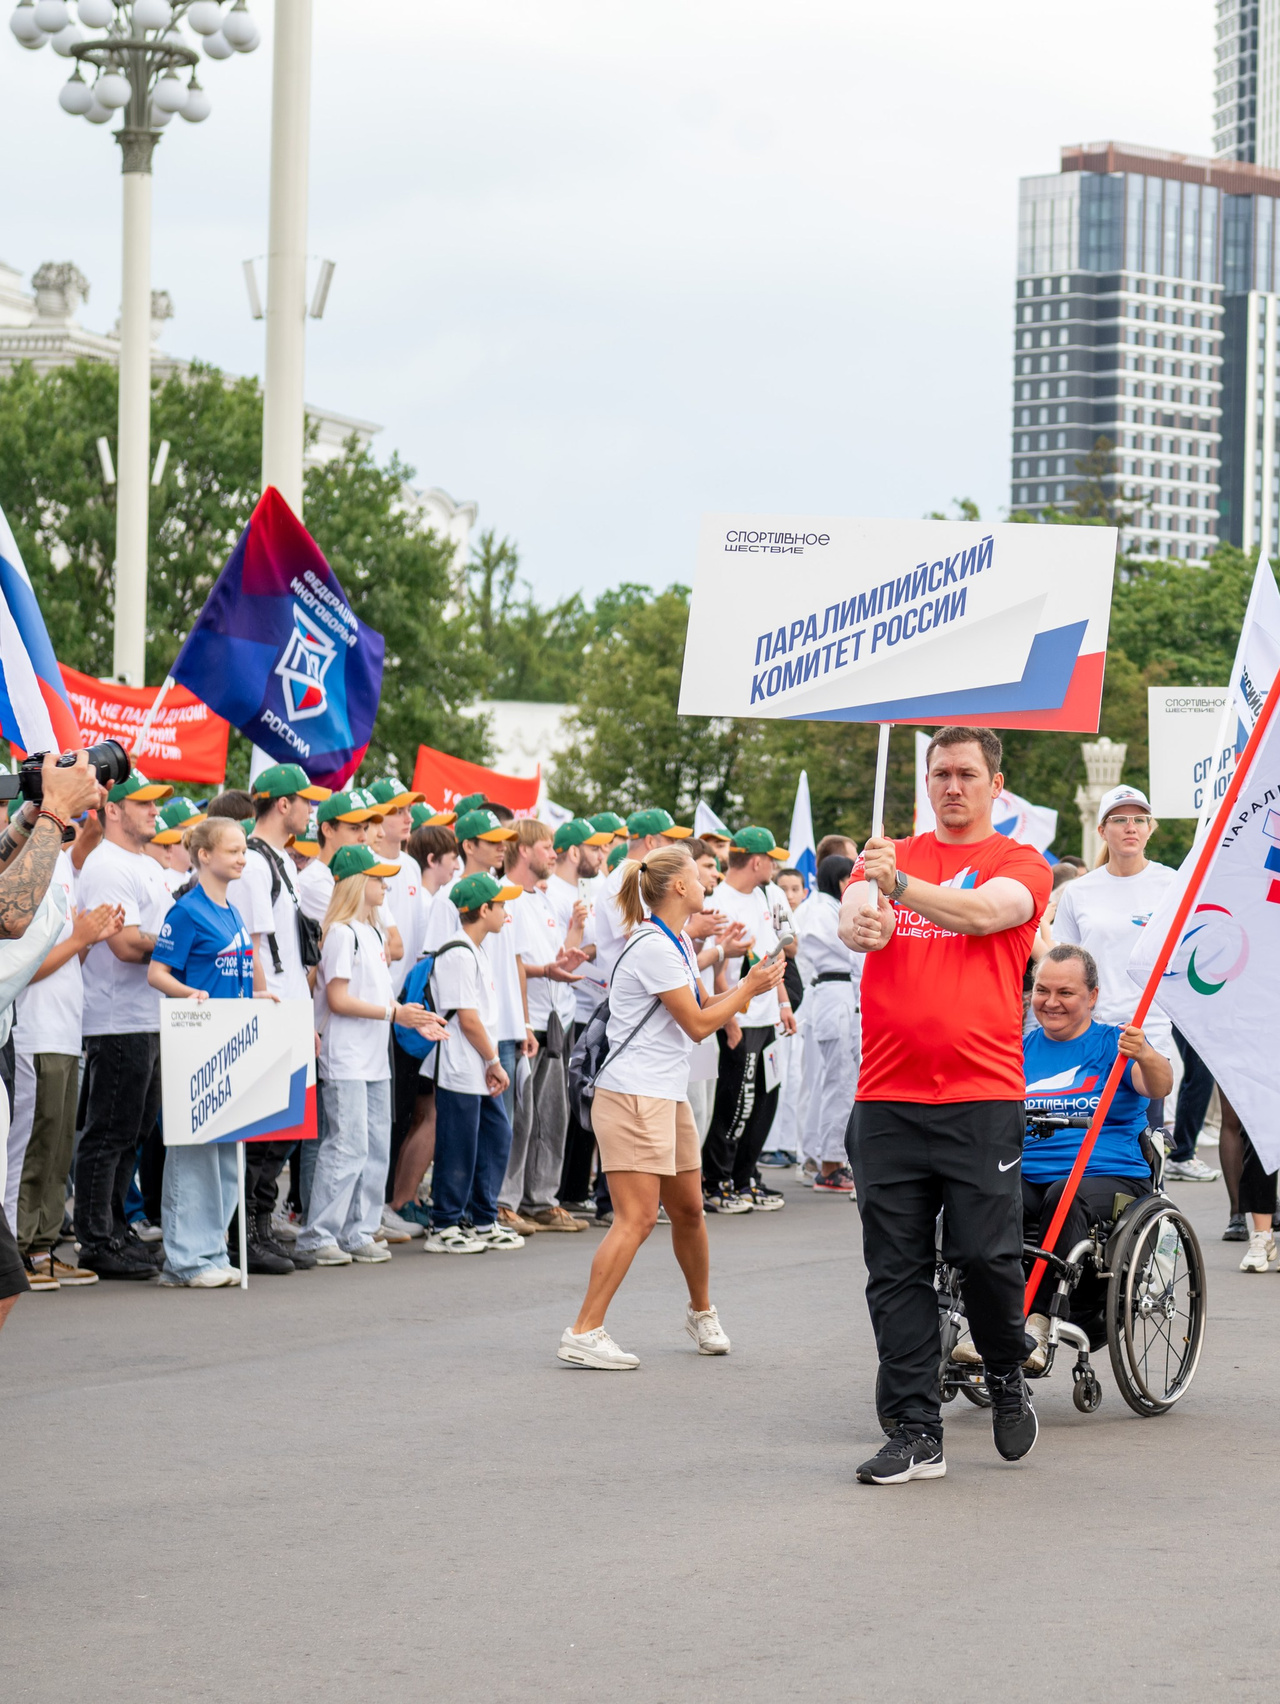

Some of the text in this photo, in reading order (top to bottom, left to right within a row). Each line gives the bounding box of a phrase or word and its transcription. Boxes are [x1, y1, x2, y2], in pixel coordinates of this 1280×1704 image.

[724, 544, 804, 554] ШЕСТВИЕ
[290, 576, 358, 648] МНОГОБОРЬЯ
[303, 569, 359, 632] ФЕДЕРАЦИЯ
[754, 534, 995, 667] ПАРАЛИМПИЙСКИЙ
[750, 586, 968, 706] КОМИТЕТ РОССИИ
[260, 709, 310, 758] РОССИИ
[190, 1015, 259, 1102] СПОРТИВНАЯ
[191, 1075, 232, 1134] БОРЬБА
